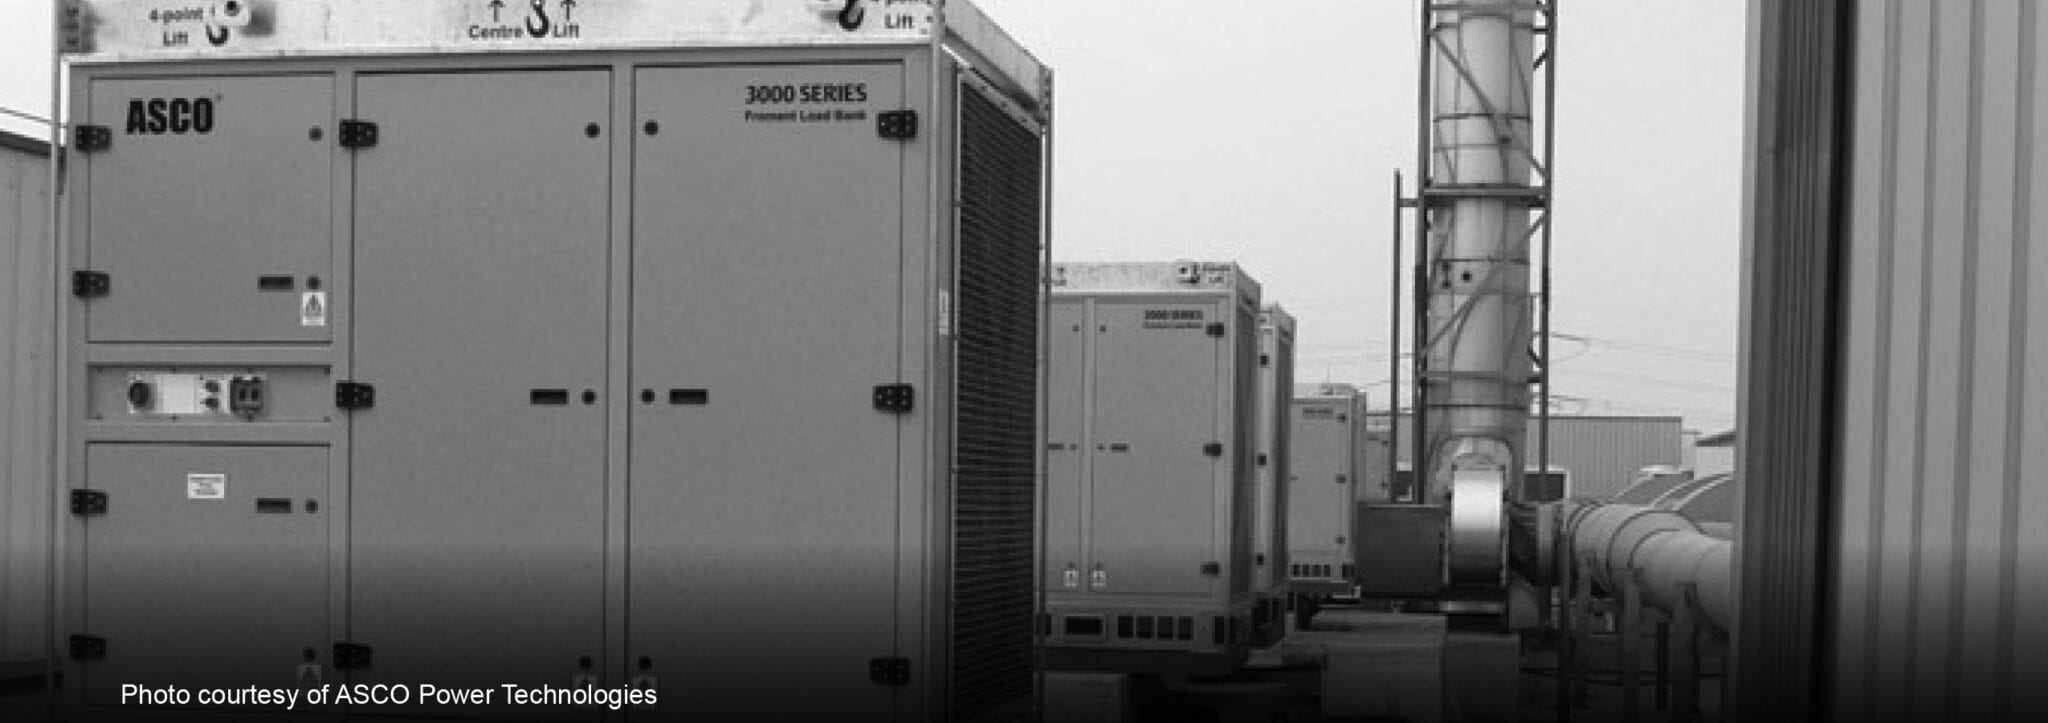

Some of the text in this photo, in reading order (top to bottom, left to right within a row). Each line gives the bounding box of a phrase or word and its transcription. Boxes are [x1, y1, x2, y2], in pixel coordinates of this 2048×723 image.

[469, 23, 580, 38] Centre Lift
[745, 83, 867, 104] 3000 SERIES
[126, 98, 213, 134] ASCO
